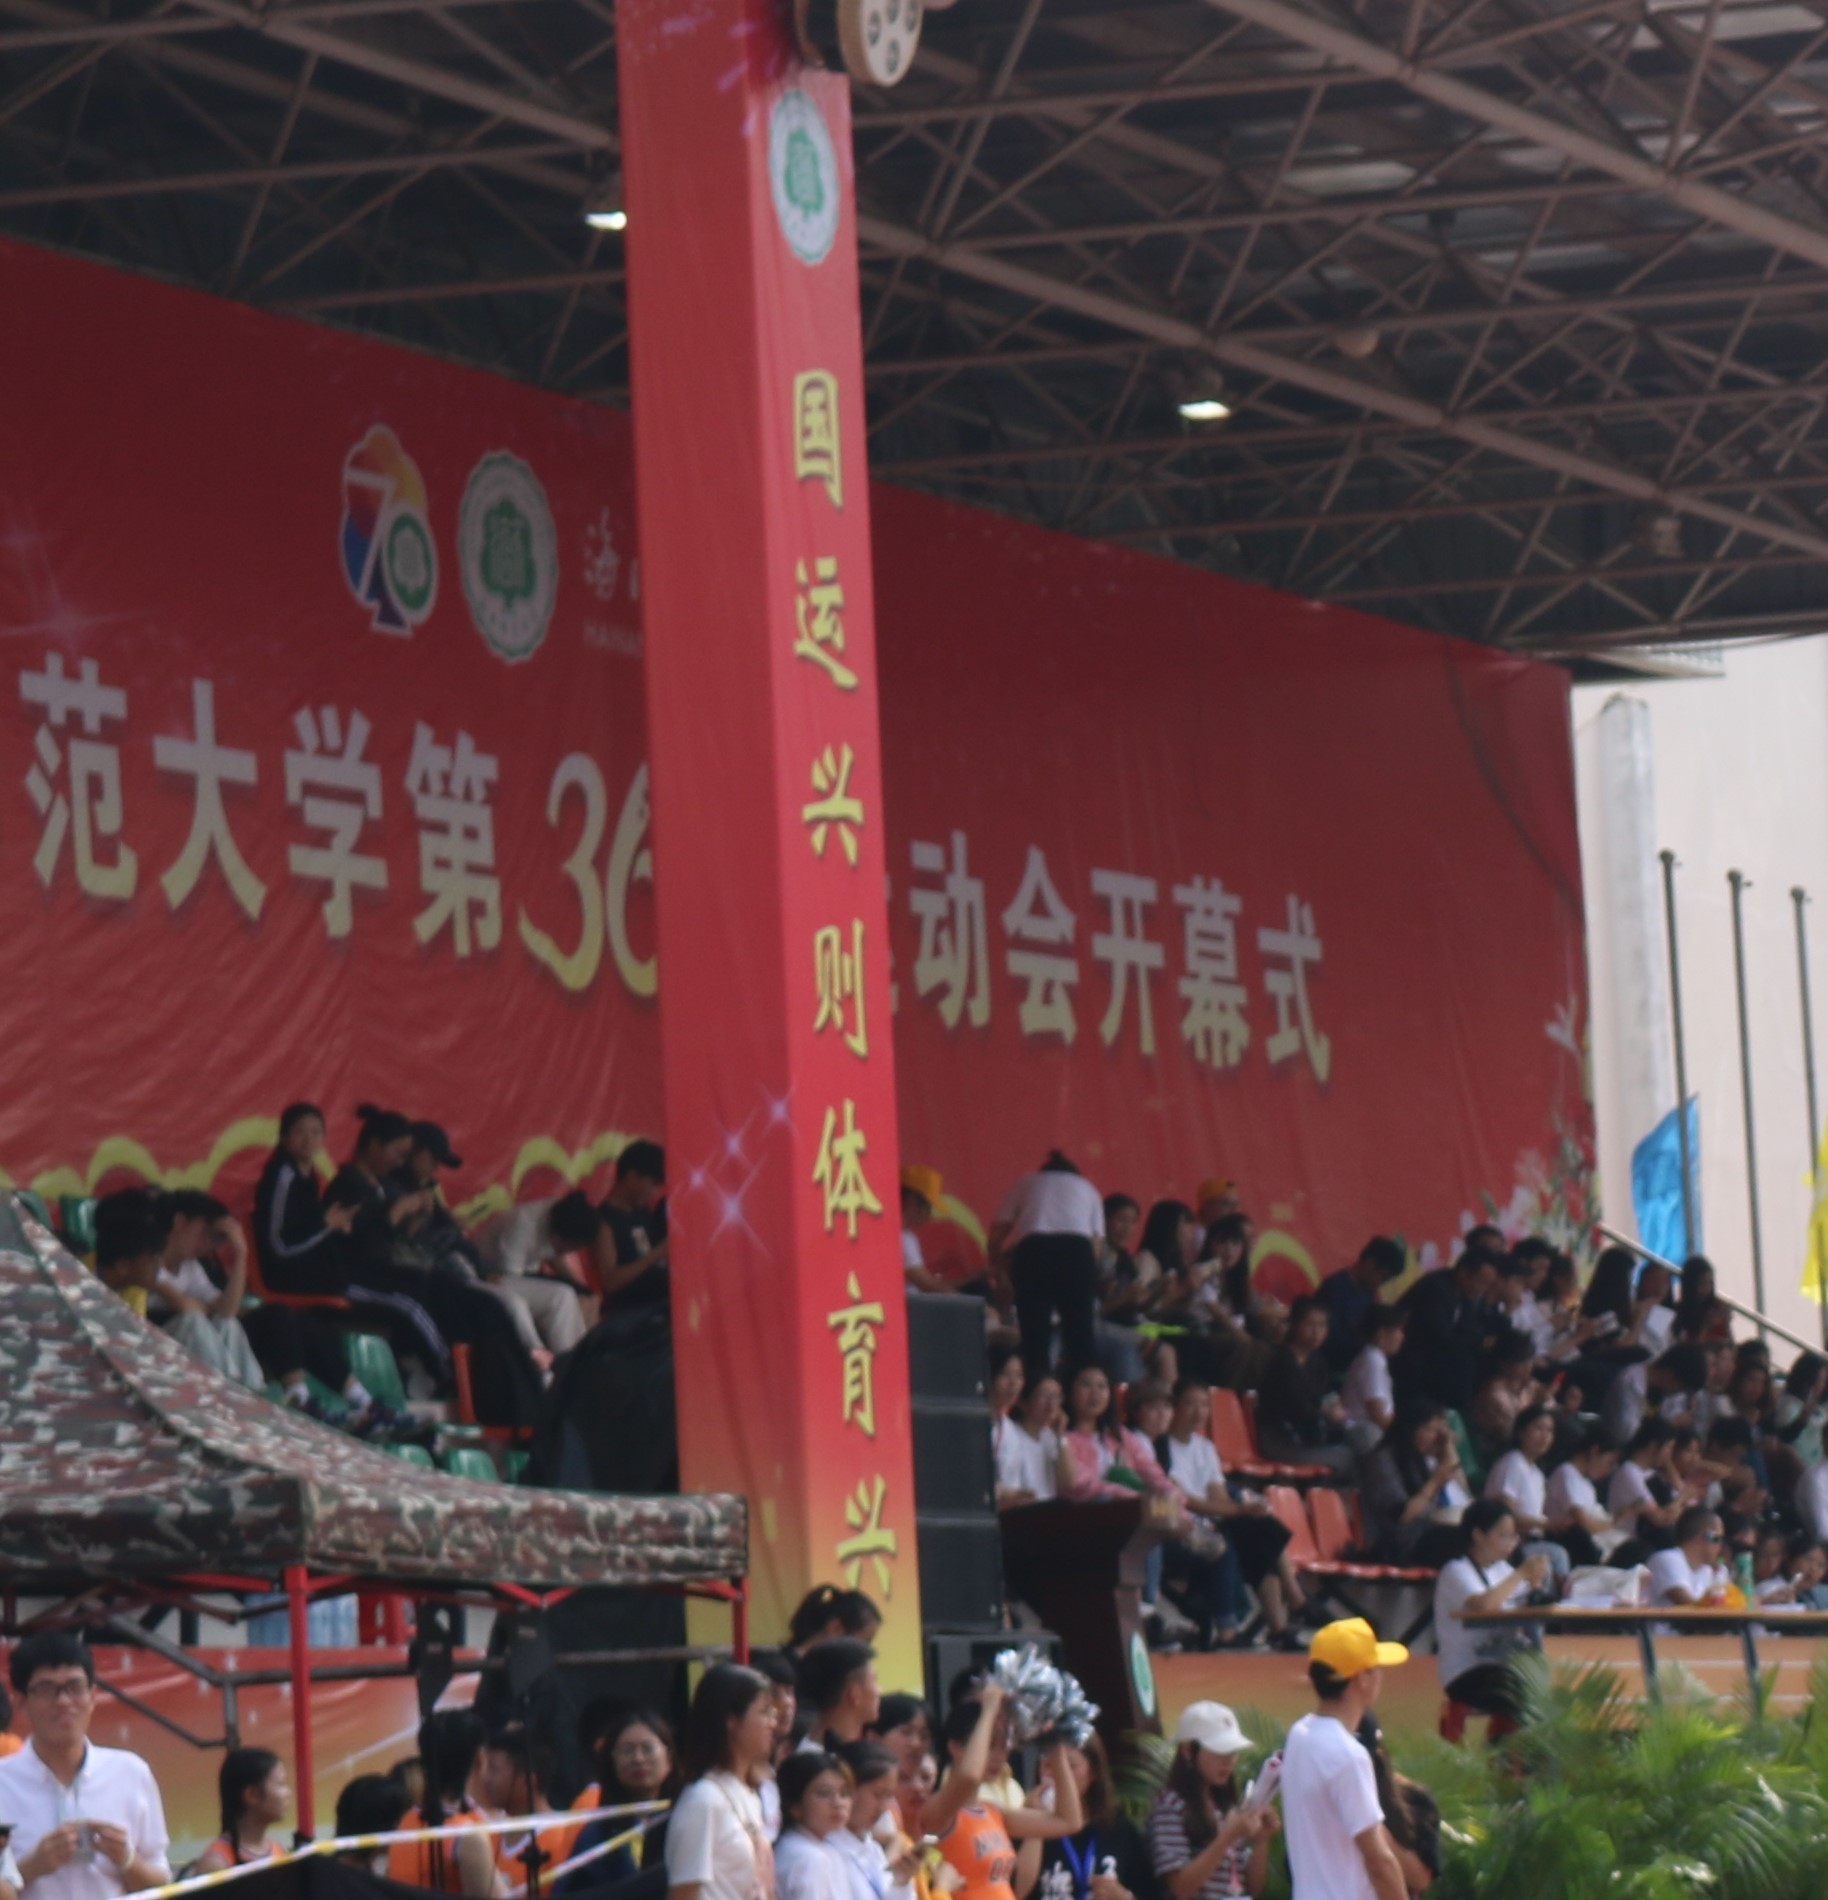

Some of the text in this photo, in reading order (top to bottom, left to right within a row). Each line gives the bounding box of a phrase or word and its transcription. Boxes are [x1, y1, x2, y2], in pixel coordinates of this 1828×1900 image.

[793, 368, 897, 1597] 国运兴则体育兴
[886, 830, 1330, 1084] 动会开幕式
